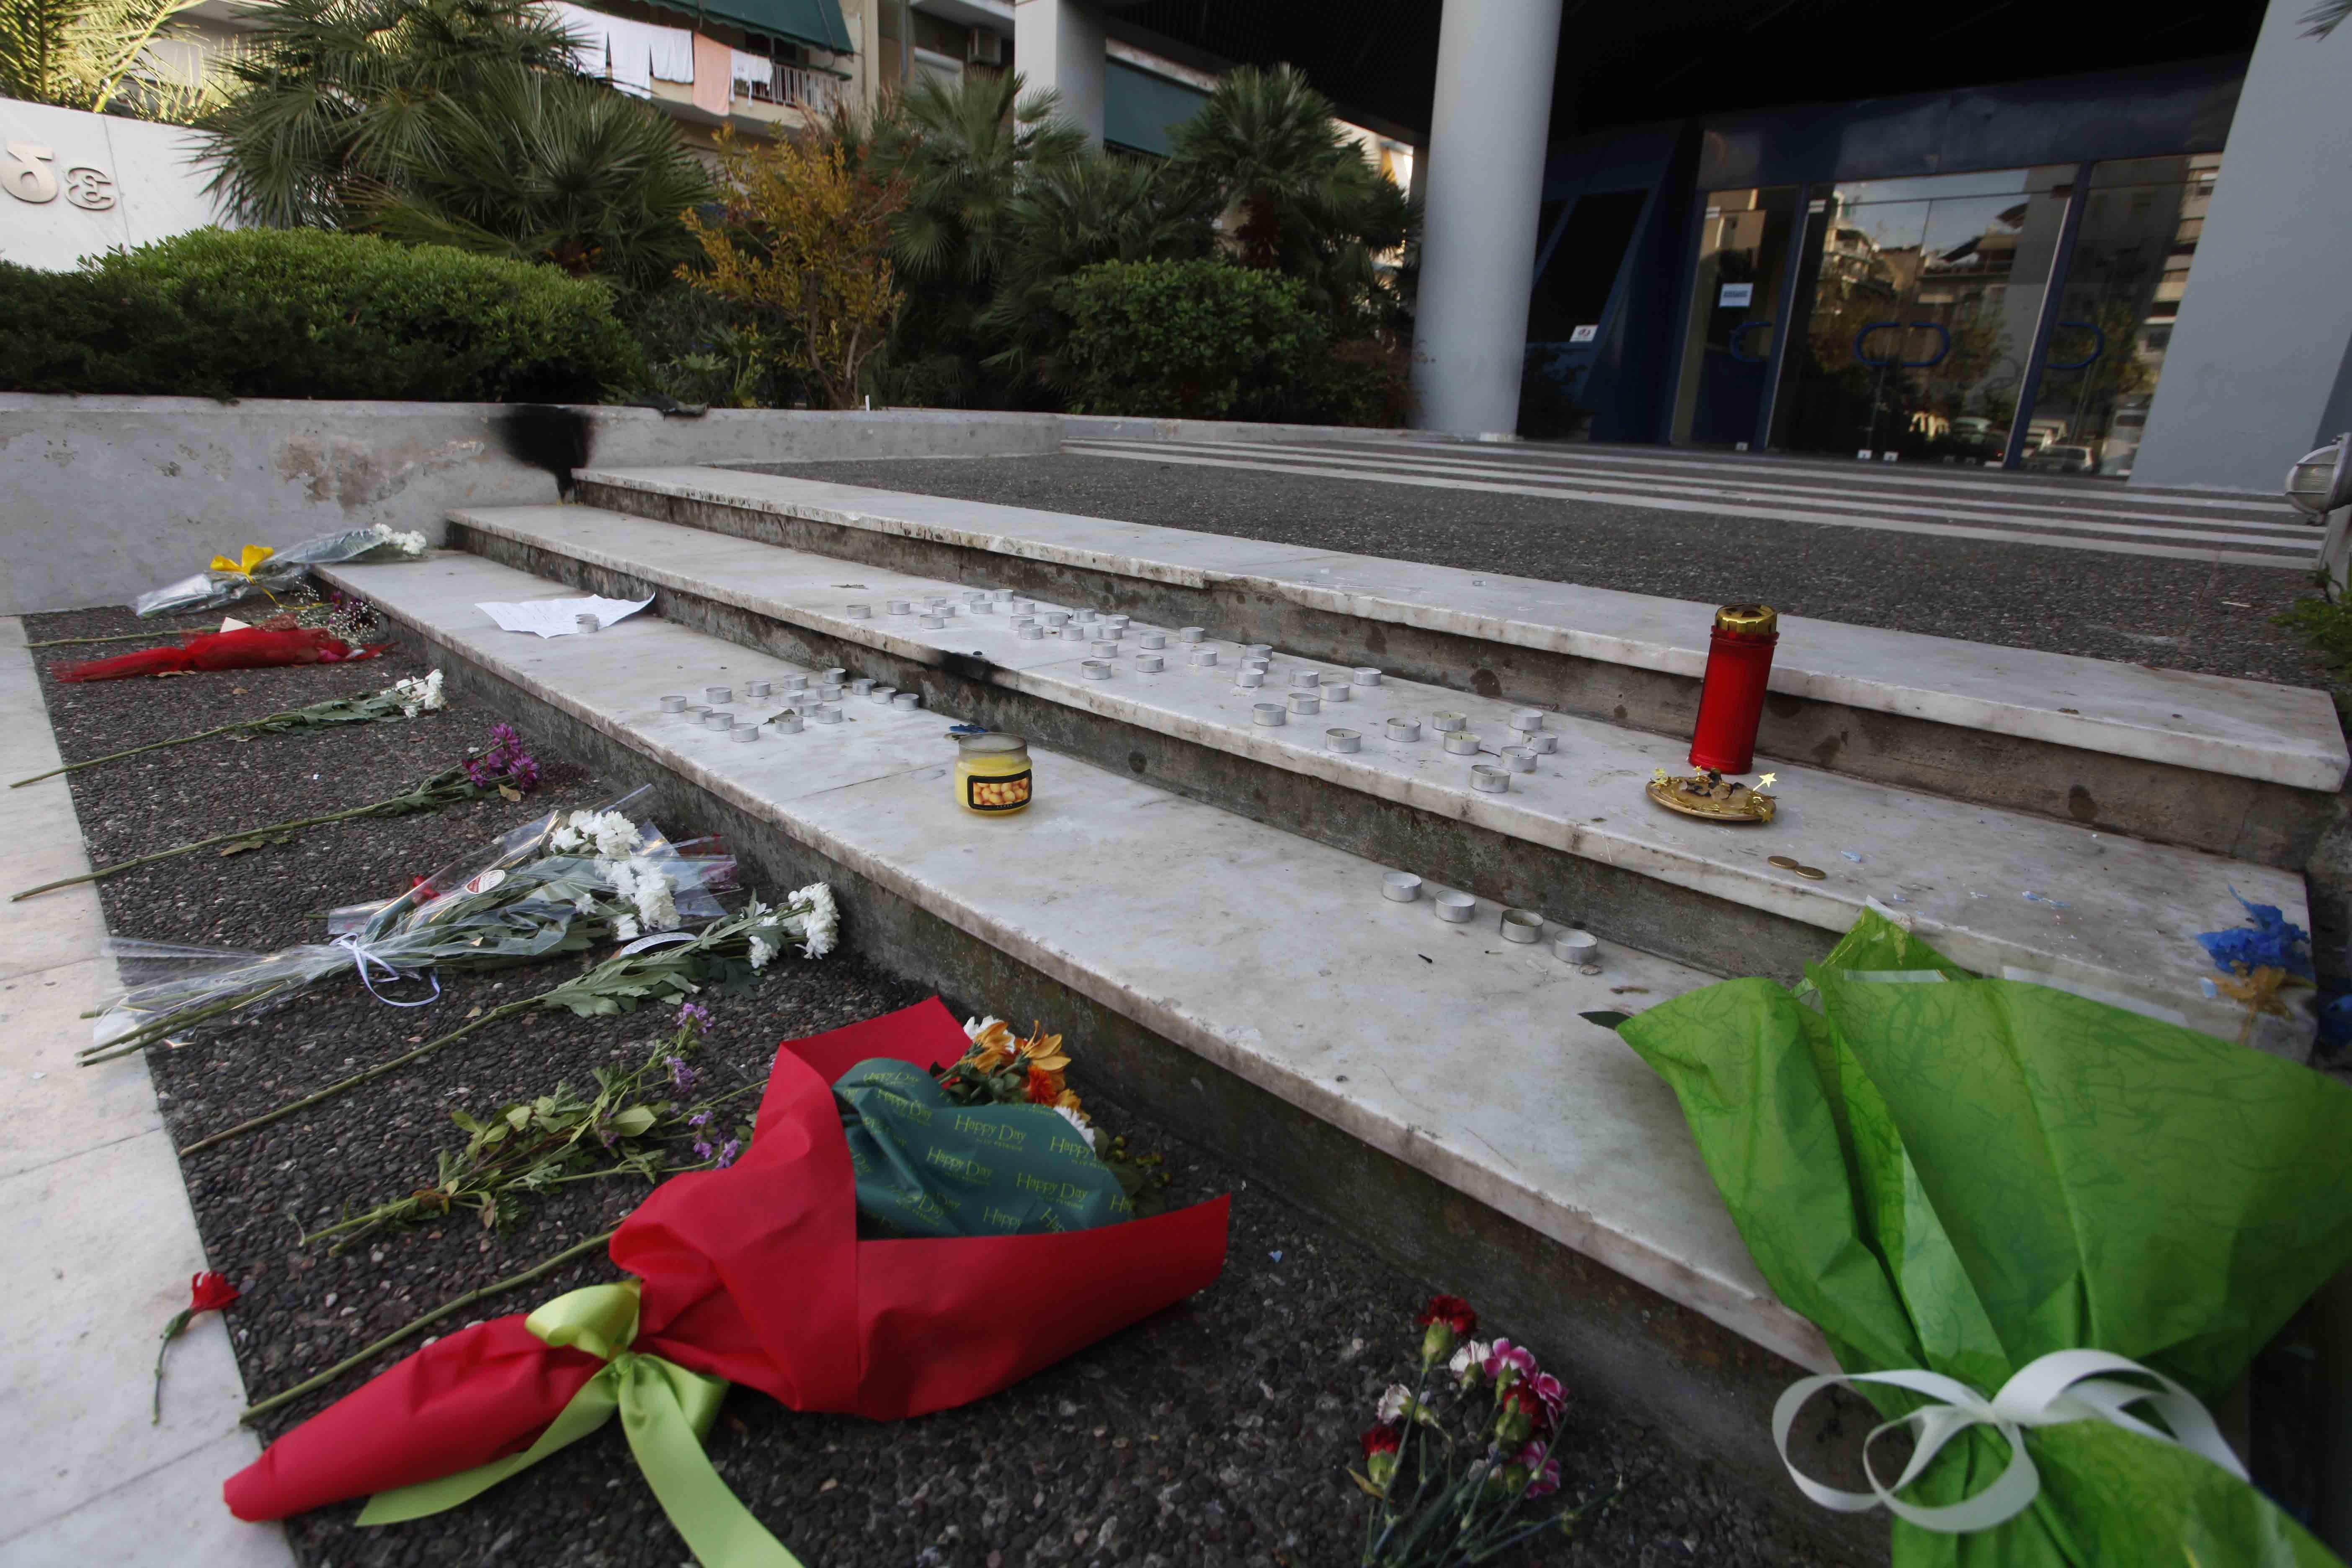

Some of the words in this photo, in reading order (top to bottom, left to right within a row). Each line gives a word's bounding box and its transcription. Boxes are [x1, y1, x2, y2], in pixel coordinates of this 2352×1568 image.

[954, 1114, 997, 1138] Happy
[998, 1124, 1026, 1145] Day
[1049, 1136, 1091, 1159] Happy
[926, 1146, 965, 1171] Happy
[966, 1159, 992, 1179] Day
[1016, 1173, 1058, 1194] Happy
[1060, 1183, 1087, 1202] Day
[983, 1206, 1022, 1231] Happy
